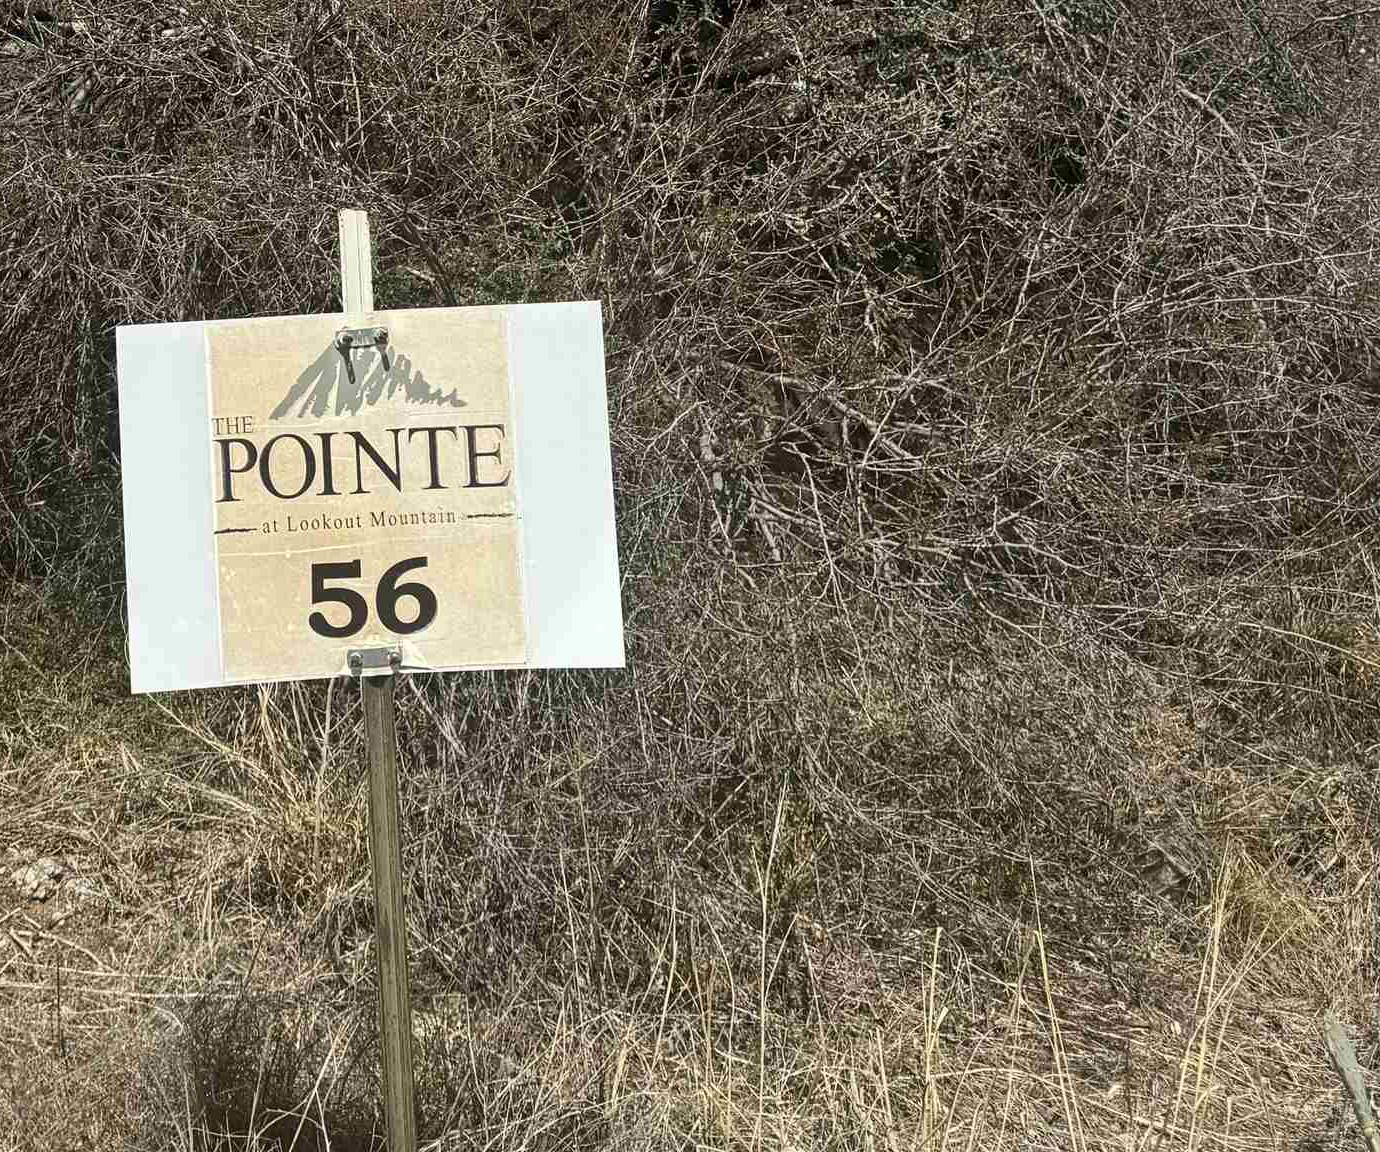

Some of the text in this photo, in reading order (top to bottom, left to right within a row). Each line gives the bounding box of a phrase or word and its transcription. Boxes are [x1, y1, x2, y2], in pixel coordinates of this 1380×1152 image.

[212, 416, 253, 435] THE
[213, 424, 512, 503] POINTE
[262, 508, 457, 534] at Lookout Mountain
[308, 557, 438, 639] 56
